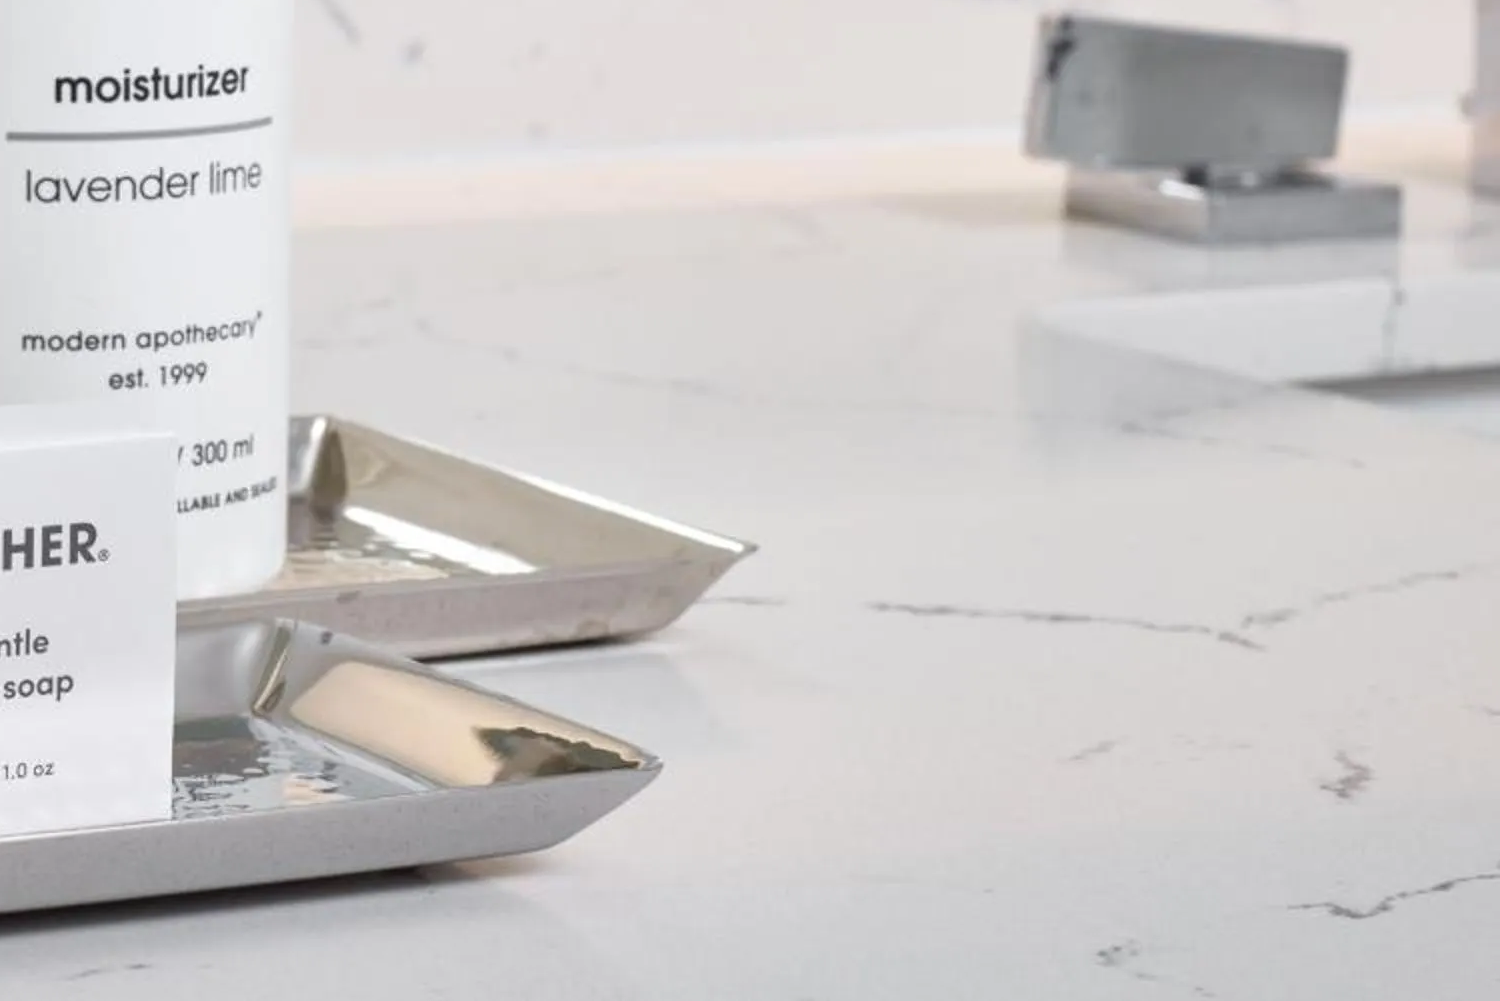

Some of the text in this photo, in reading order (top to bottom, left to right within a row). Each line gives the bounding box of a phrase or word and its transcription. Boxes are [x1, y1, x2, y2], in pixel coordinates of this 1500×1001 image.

[54, 64, 249, 103] moisturizer
[26, 162, 261, 204] lavender lime
[22, 331, 126, 352] modern
[108, 361, 207, 390] est. 1999
[192, 439, 228, 467] 300
[233, 435, 254, 459] ml
[177, 493, 220, 514] LLABLE
[4, 675, 74, 702] soap
[2, 762, 27, 780] 1.0
[33, 763, 54, 777] oz
